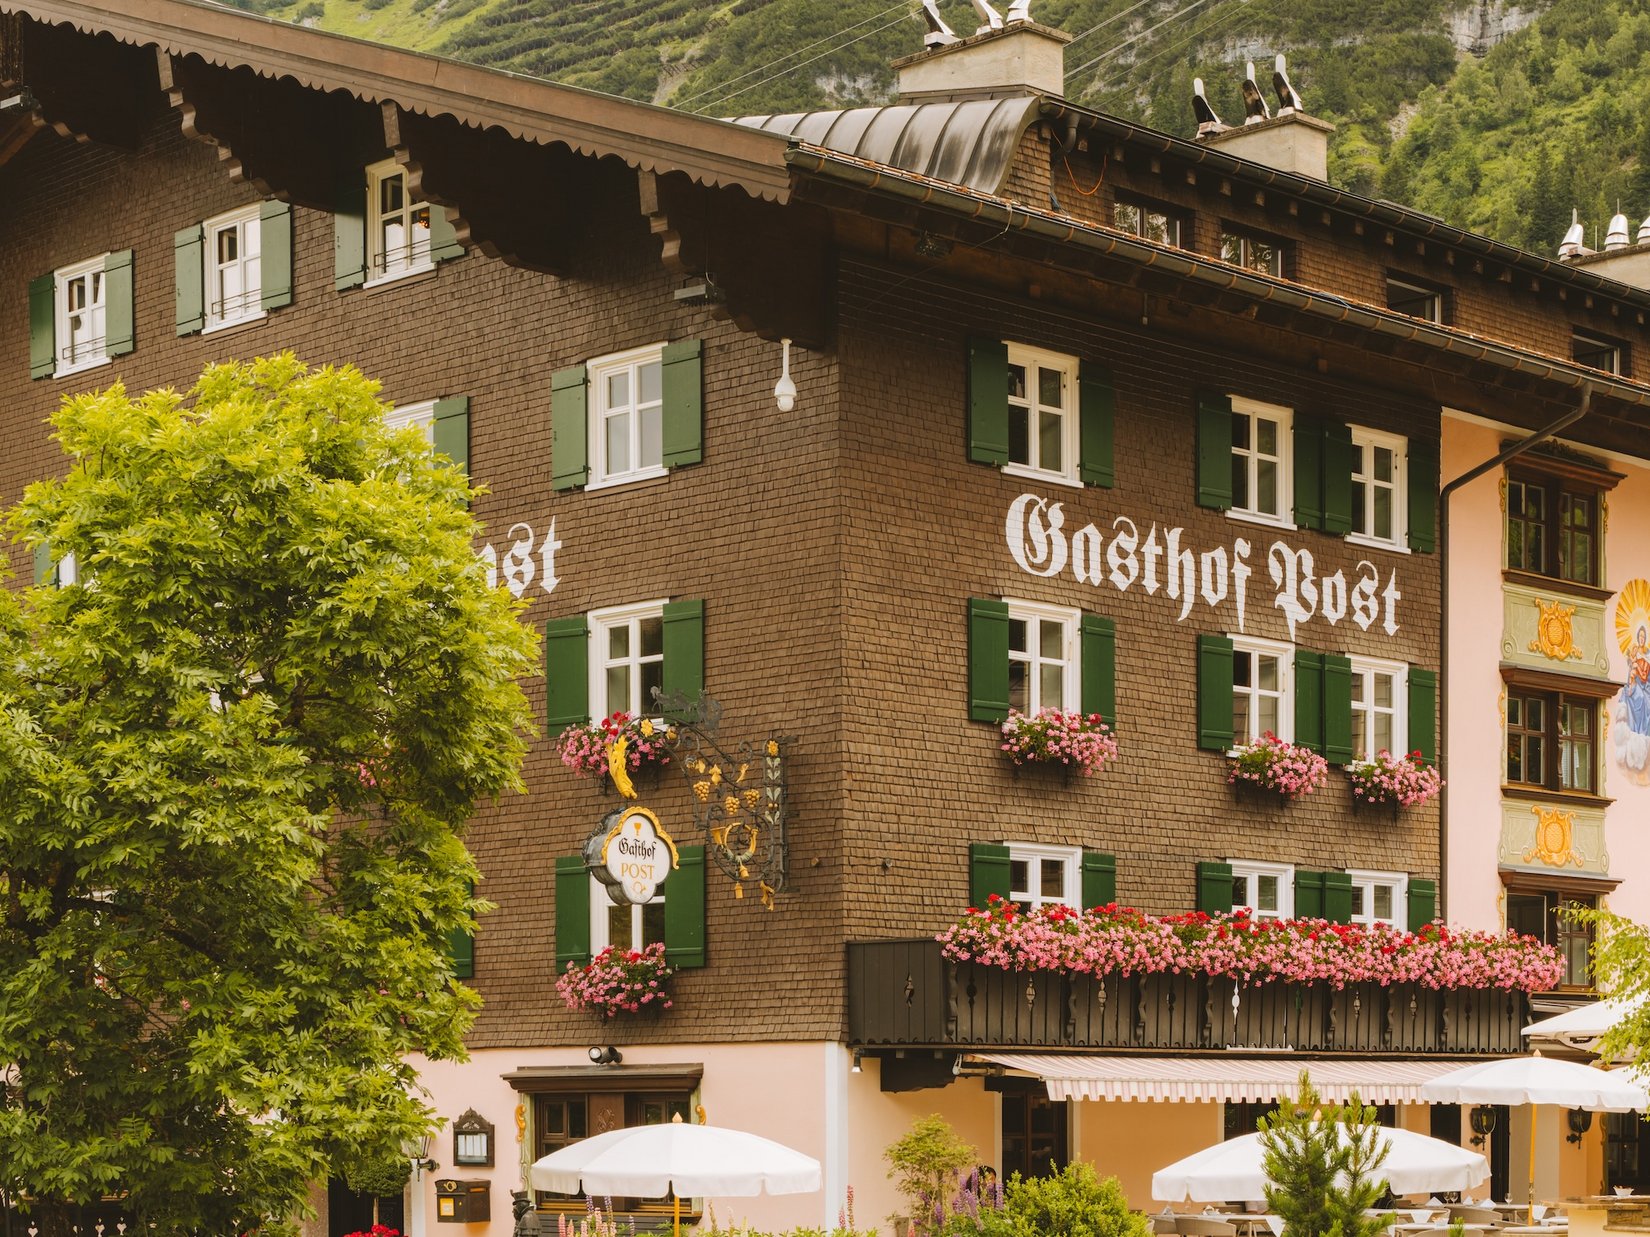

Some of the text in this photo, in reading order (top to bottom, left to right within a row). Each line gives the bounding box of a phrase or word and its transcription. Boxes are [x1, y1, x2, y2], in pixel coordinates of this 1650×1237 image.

[1005, 493, 1401, 641] Gasthof Post
[621, 862, 655, 880] POST
